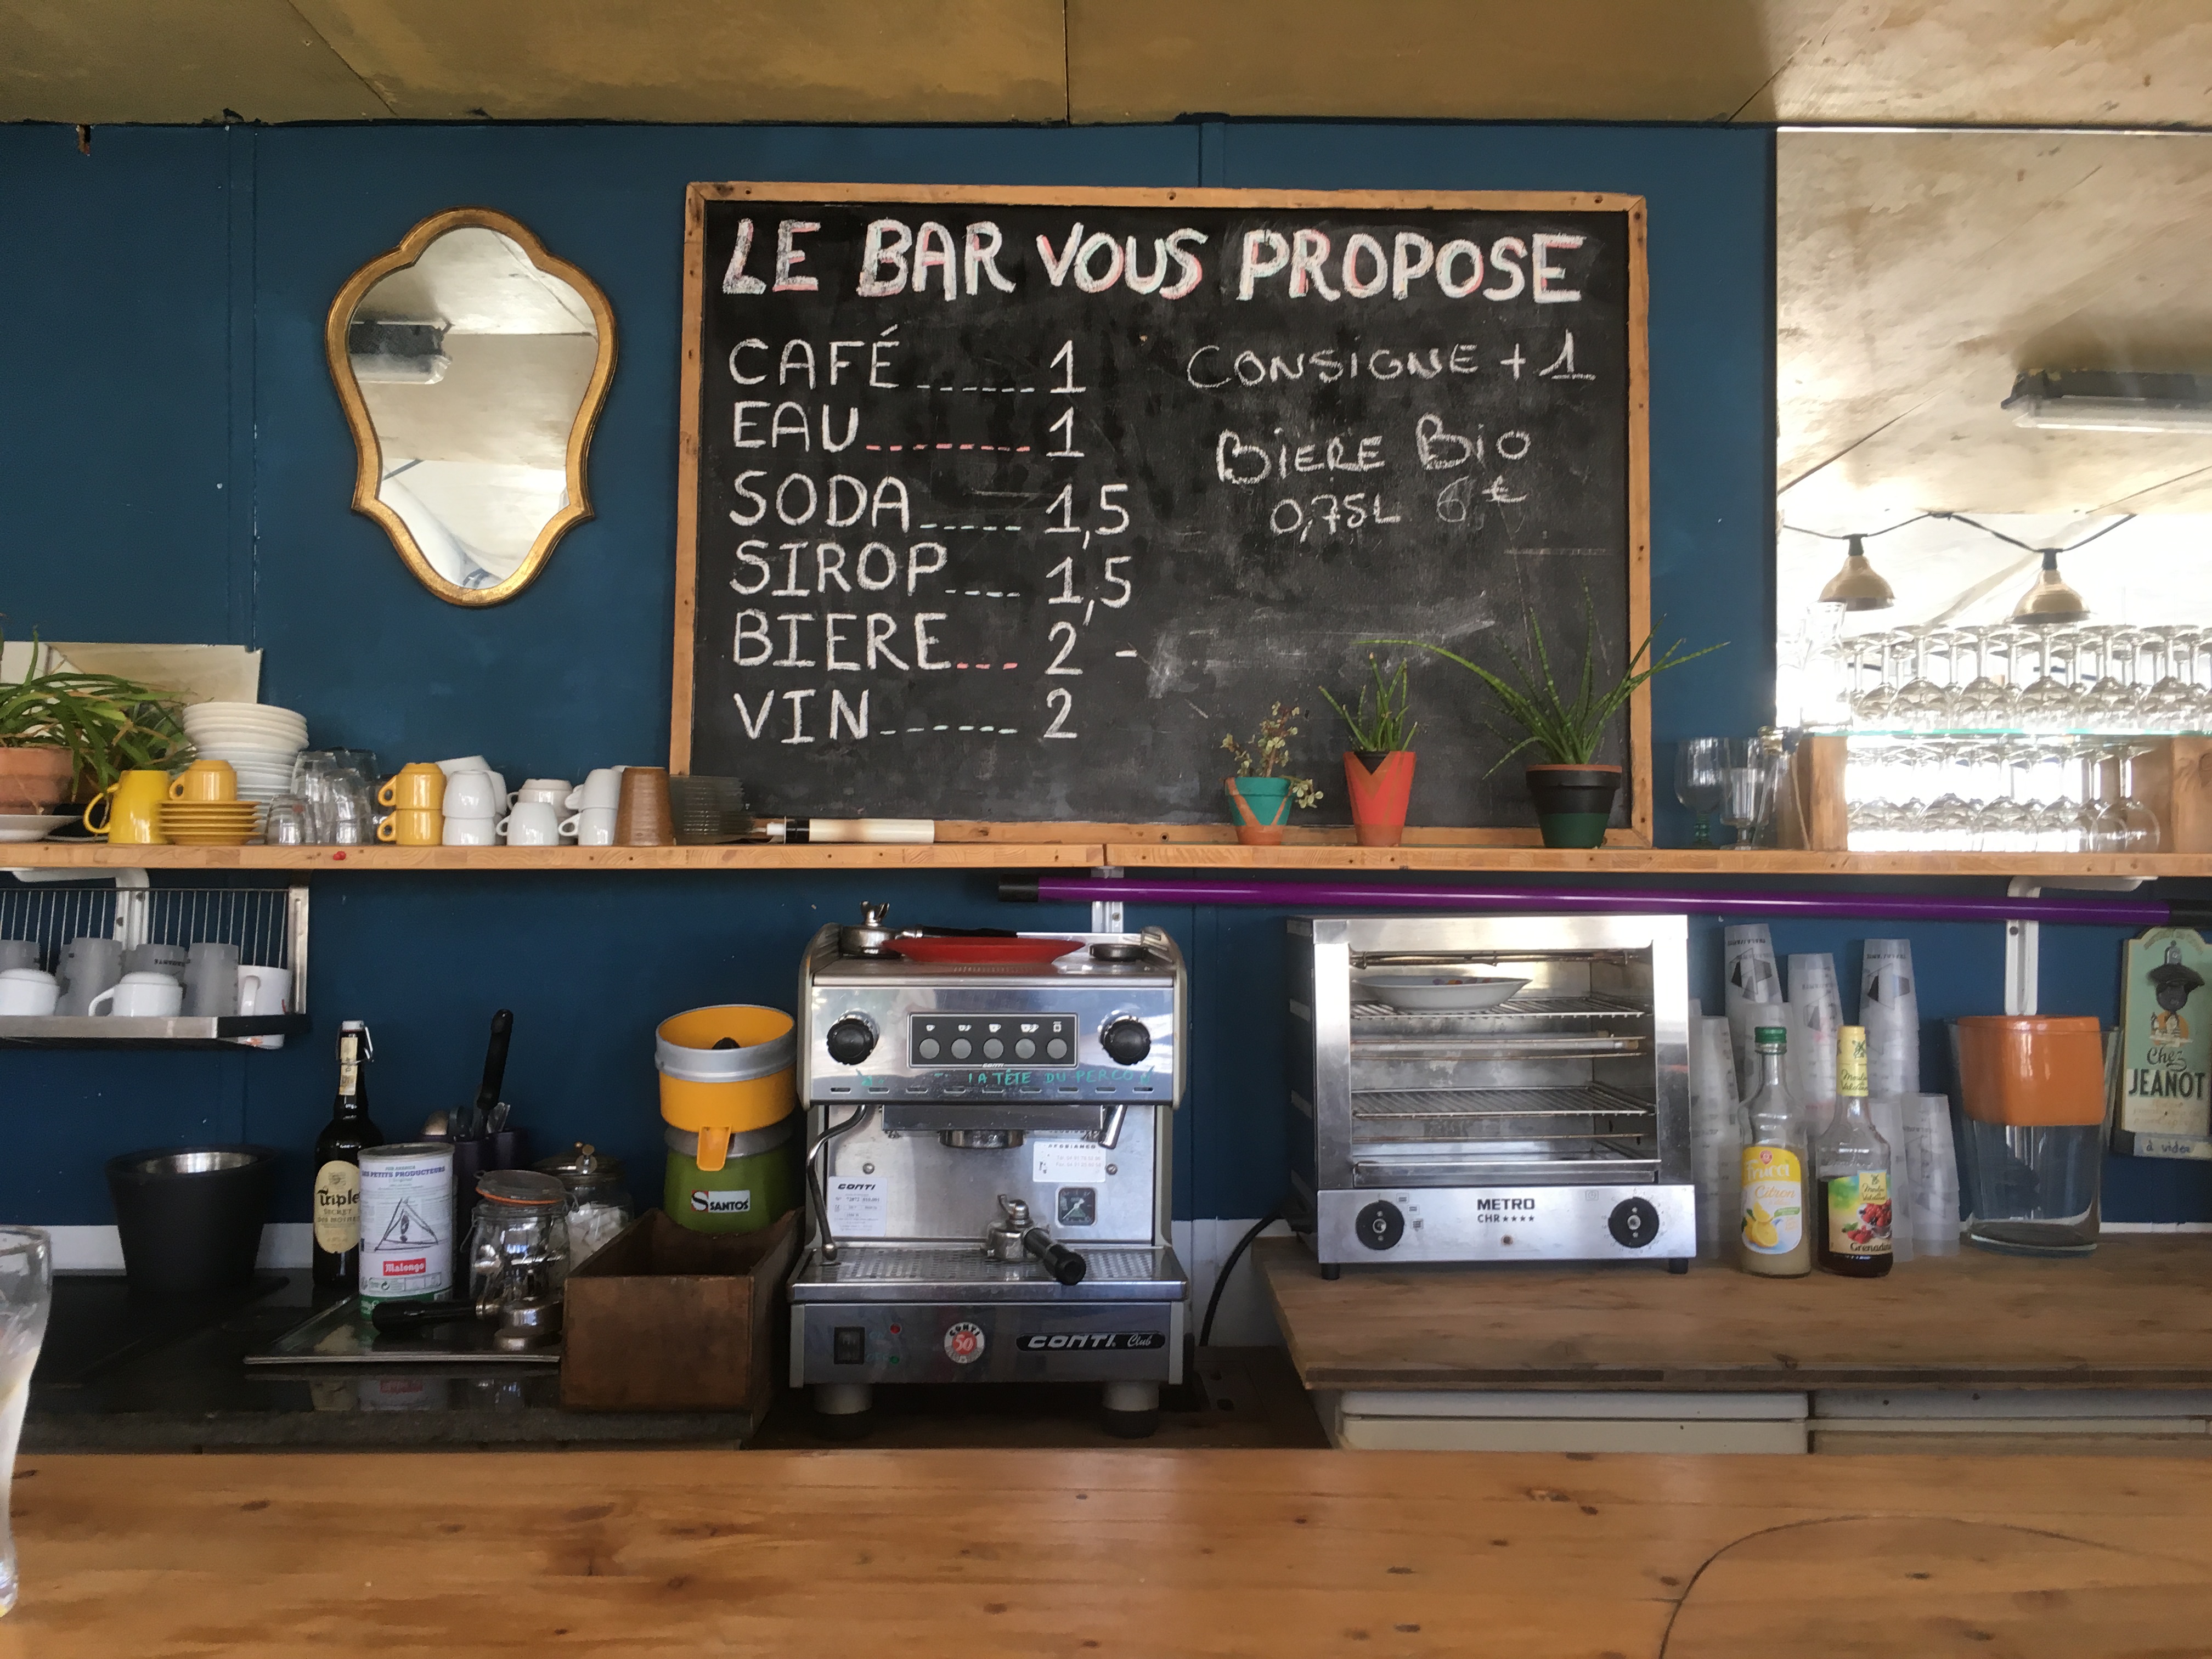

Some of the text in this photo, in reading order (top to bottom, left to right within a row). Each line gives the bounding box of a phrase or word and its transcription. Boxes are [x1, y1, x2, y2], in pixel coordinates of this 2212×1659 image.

[723, 217, 1587, 303] LE BAR VOUS PROPOSE
[729, 324, 1086, 394] CAFÉ 1
[1186, 344, 1479, 389] CONSIGNE
[732, 400, 1085, 458] EAU 1
[729, 470, 1130, 550] SODA 1,5
[729, 540, 1132, 626] SIROP 1,5
[732, 608, 952, 672] BIERE
[1044, 620, 1084, 676] 2
[733, 688, 1077, 744] VIN 2
[2146, 1046, 2187, 1073] Chez
[992, 1069, 1032, 1086] TÊTE
[1045, 1073, 1066, 1085] DU
[1075, 1069, 1133, 1084] PERCO
[2128, 1068, 2205, 1099] JEANOT
[395, 1166, 445, 1177] PRODUCTEURS
[1746, 1159, 1790, 1181] Frucci
[317, 1188, 361, 1207] Triple
[1755, 1184, 1796, 1199] Citron
[710, 1198, 749, 1211] SANTOS
[1477, 1198, 1536, 1210] METRO
[1477, 1214, 1500, 1223] CHR
[385, 1262, 425, 1273] Malongo
[956, 1334, 974, 1351] 50
[1028, 1332, 1153, 1349] CONTI Club
